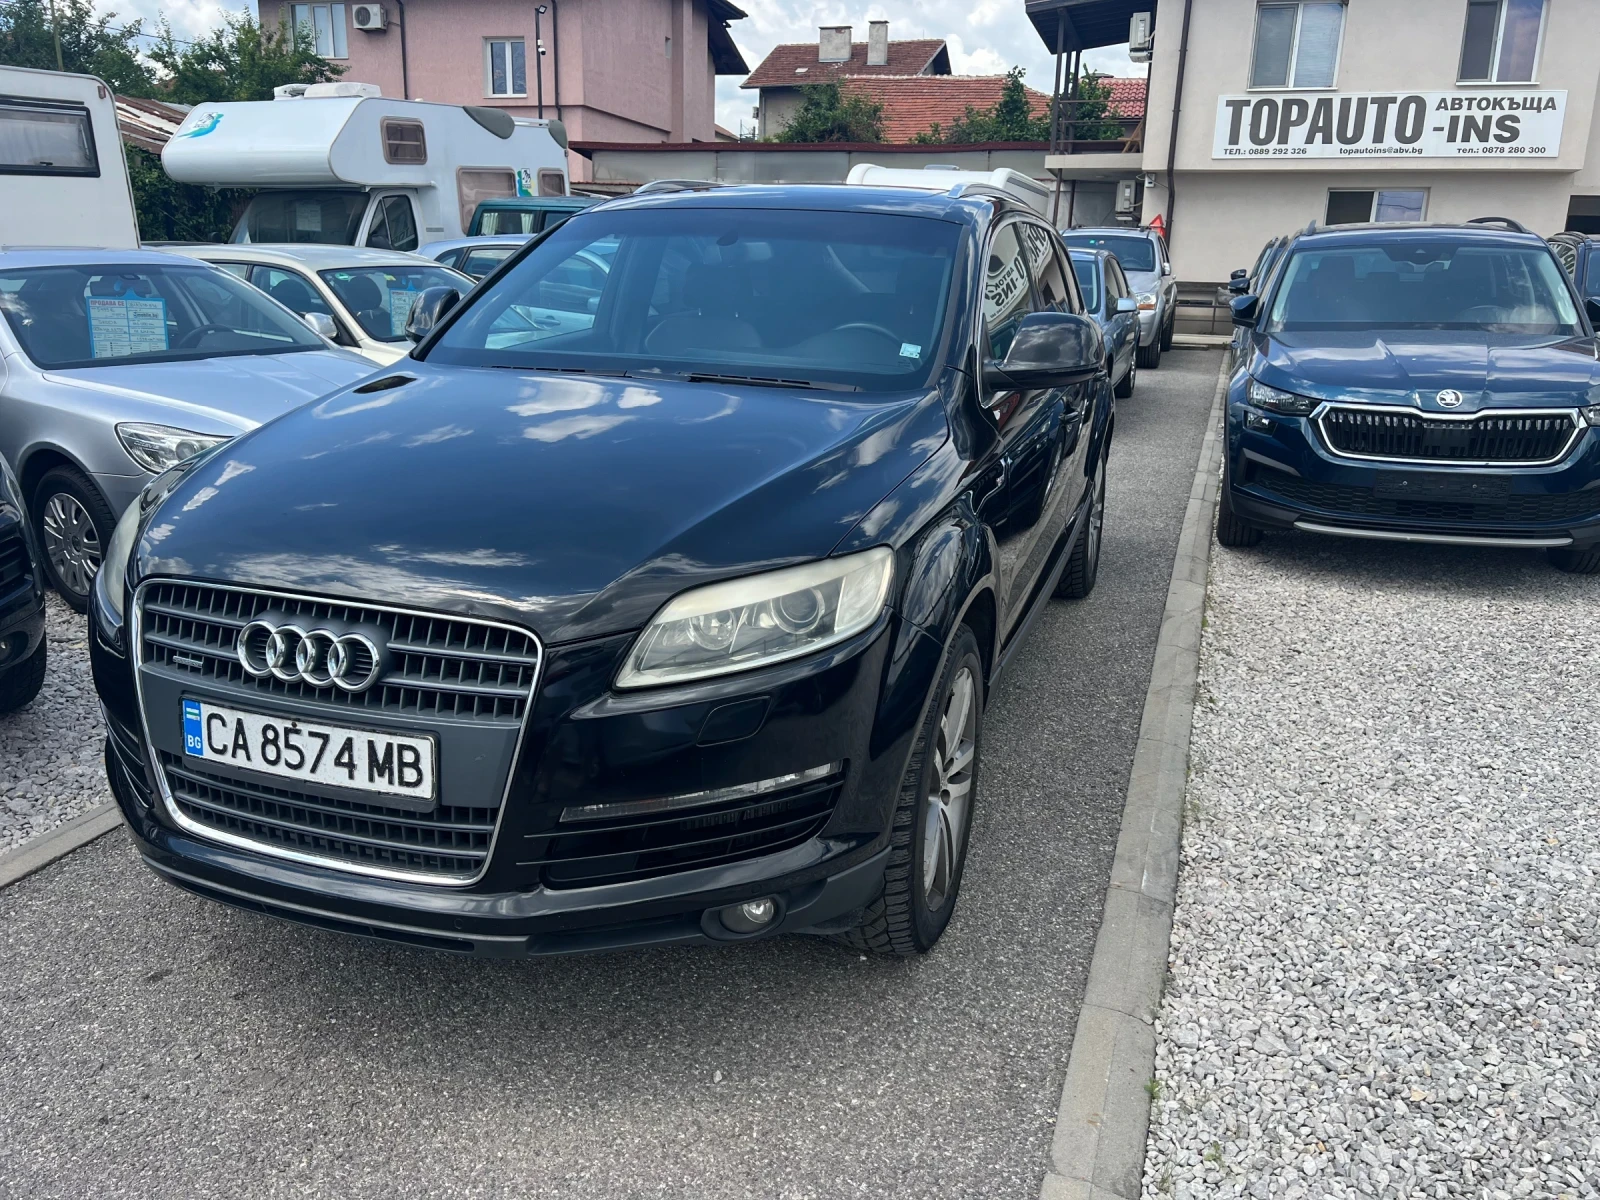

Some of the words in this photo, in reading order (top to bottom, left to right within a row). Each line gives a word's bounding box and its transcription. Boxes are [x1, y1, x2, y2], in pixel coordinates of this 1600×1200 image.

[1435, 97, 1557, 113] АВТОКЪЩА
[1226, 95, 1427, 146] TOPAUTO
[1433, 114, 1521, 144] -INS
[1290, 147, 1307, 155] 326
[1339, 147, 1423, 155] topautoins@abv.bg
[1482, 146, 1505, 154] 0878
[1508, 146, 1526, 154] 280
[1528, 146, 1546, 154] 300
[187, 734, 201, 749] BG
[260, 723, 358, 781] 8574
